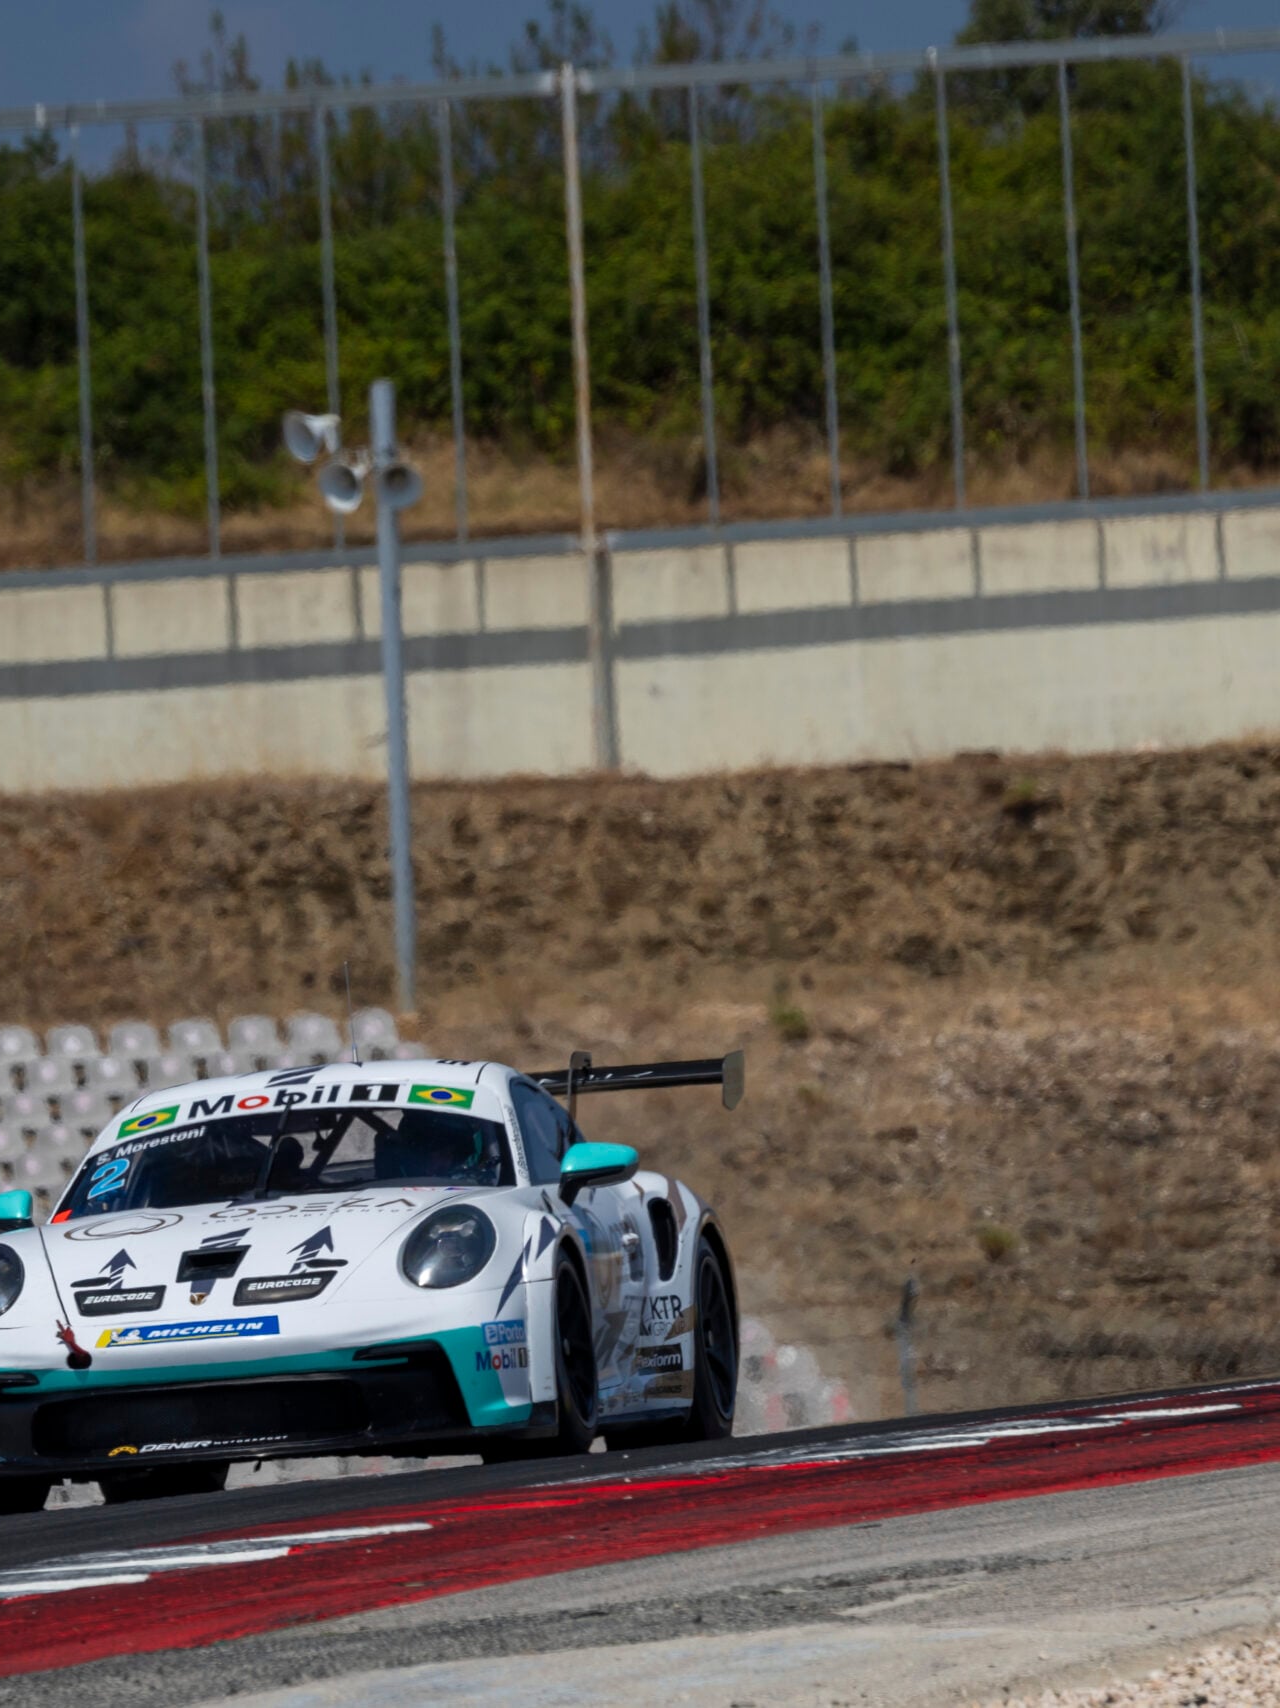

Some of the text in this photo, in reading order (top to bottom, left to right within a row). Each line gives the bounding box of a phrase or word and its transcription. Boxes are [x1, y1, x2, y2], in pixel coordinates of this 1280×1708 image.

[188, 1084, 342, 1119] Mobil
[87, 1158, 130, 1200] 2
[247, 1277, 322, 1291] EUROCODE
[83, 1291, 156, 1304] EUROCODE
[648, 1294, 684, 1320] KTR
[147, 1321, 263, 1339] MICHELIN
[475, 1347, 517, 1371] Mobil
[139, 1440, 213, 1454] DENER
